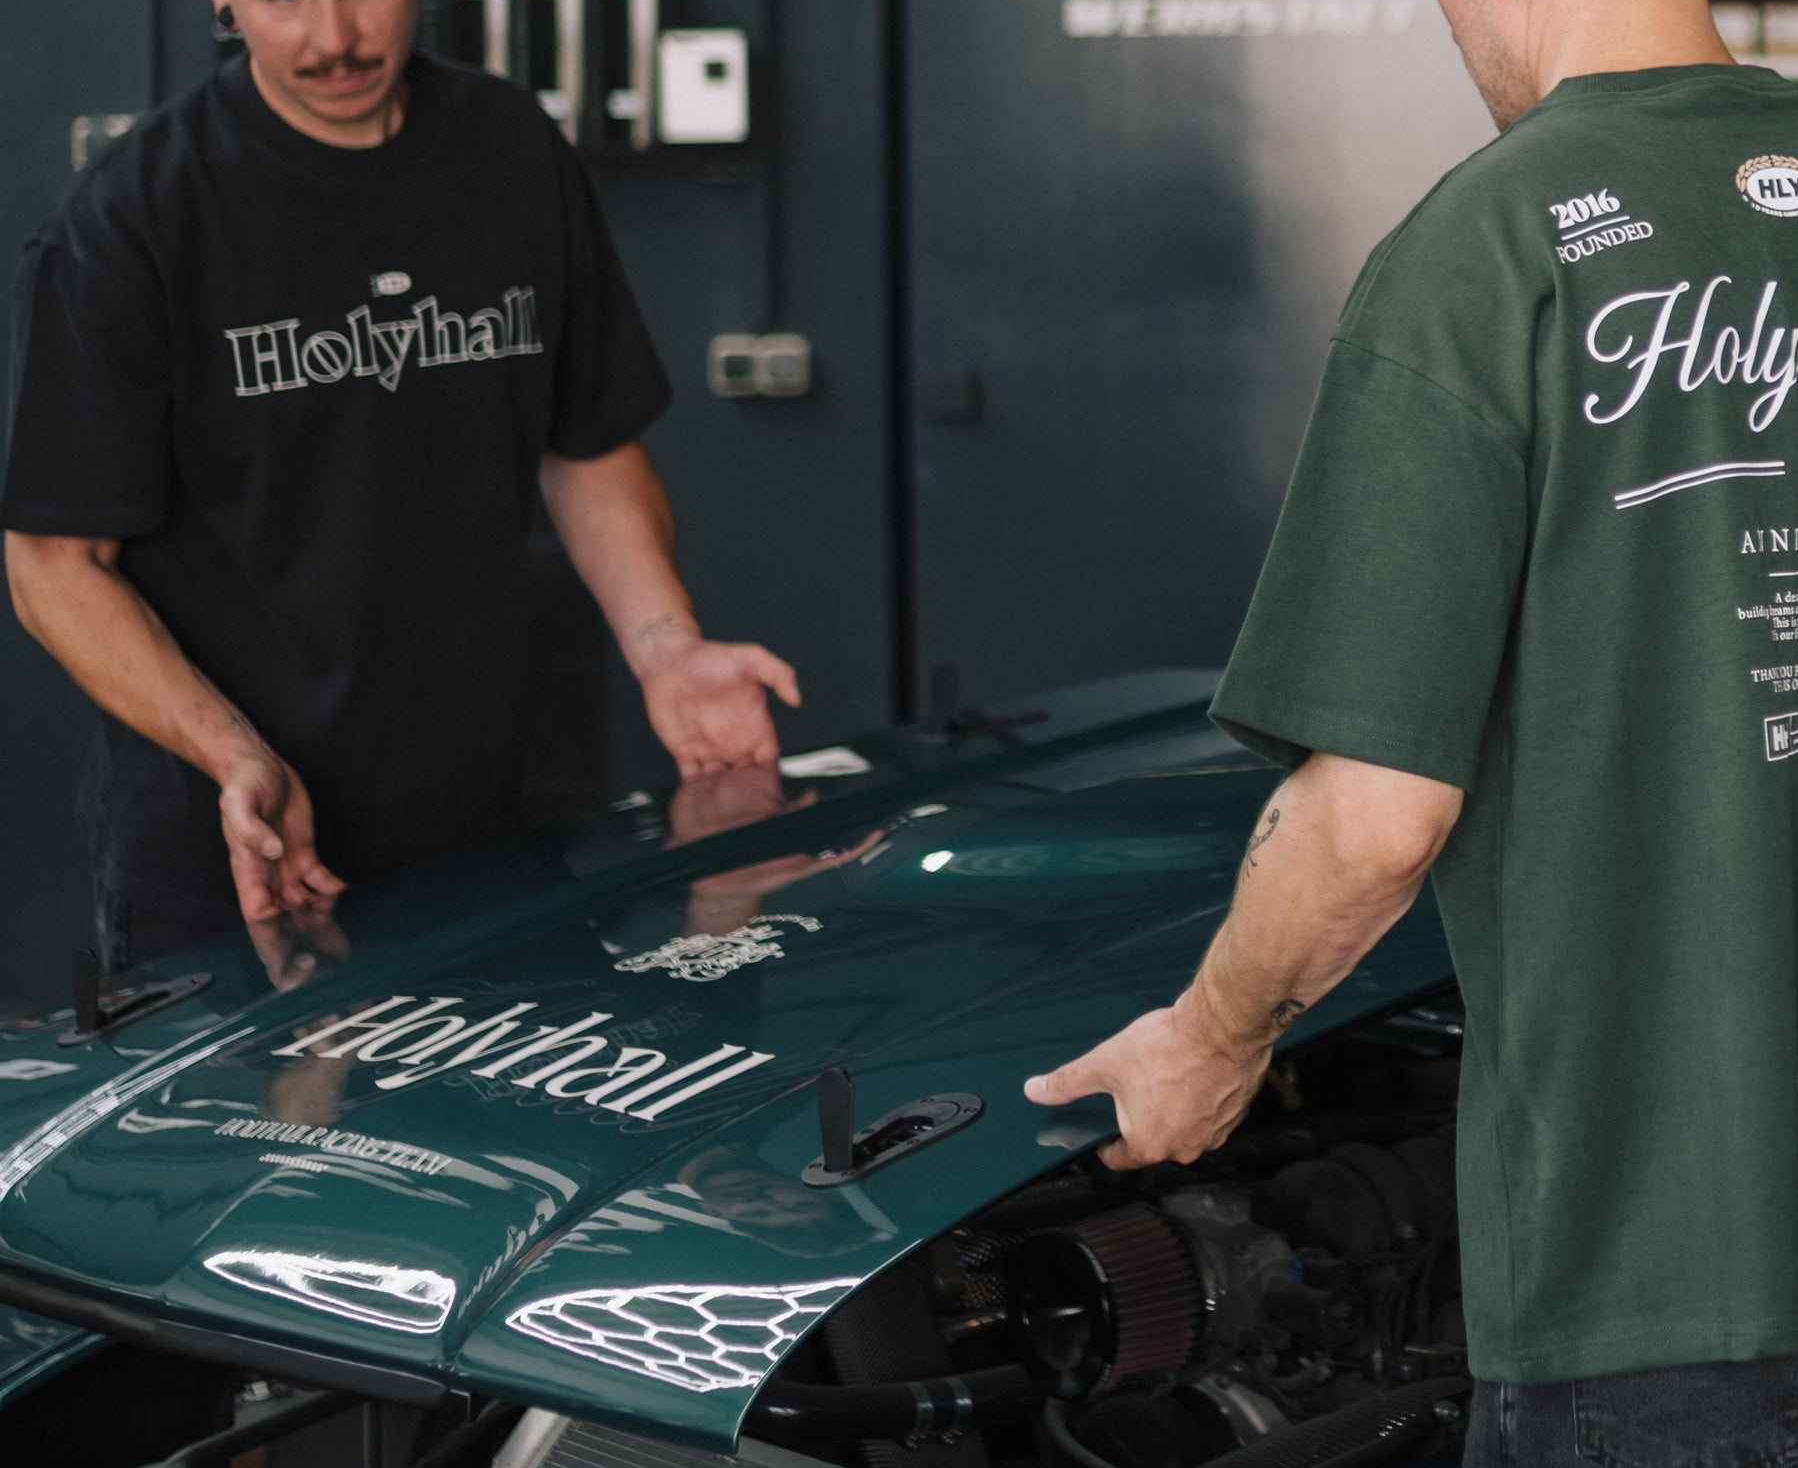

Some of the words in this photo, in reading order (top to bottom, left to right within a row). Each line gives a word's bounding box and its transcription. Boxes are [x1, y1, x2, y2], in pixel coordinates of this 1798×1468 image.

[1549, 188, 1621, 229] 2016
[1555, 221, 1654, 264] FOUNDED
[223, 284, 544, 397] Holyhall
[270, 995, 776, 1122] Holyhall
